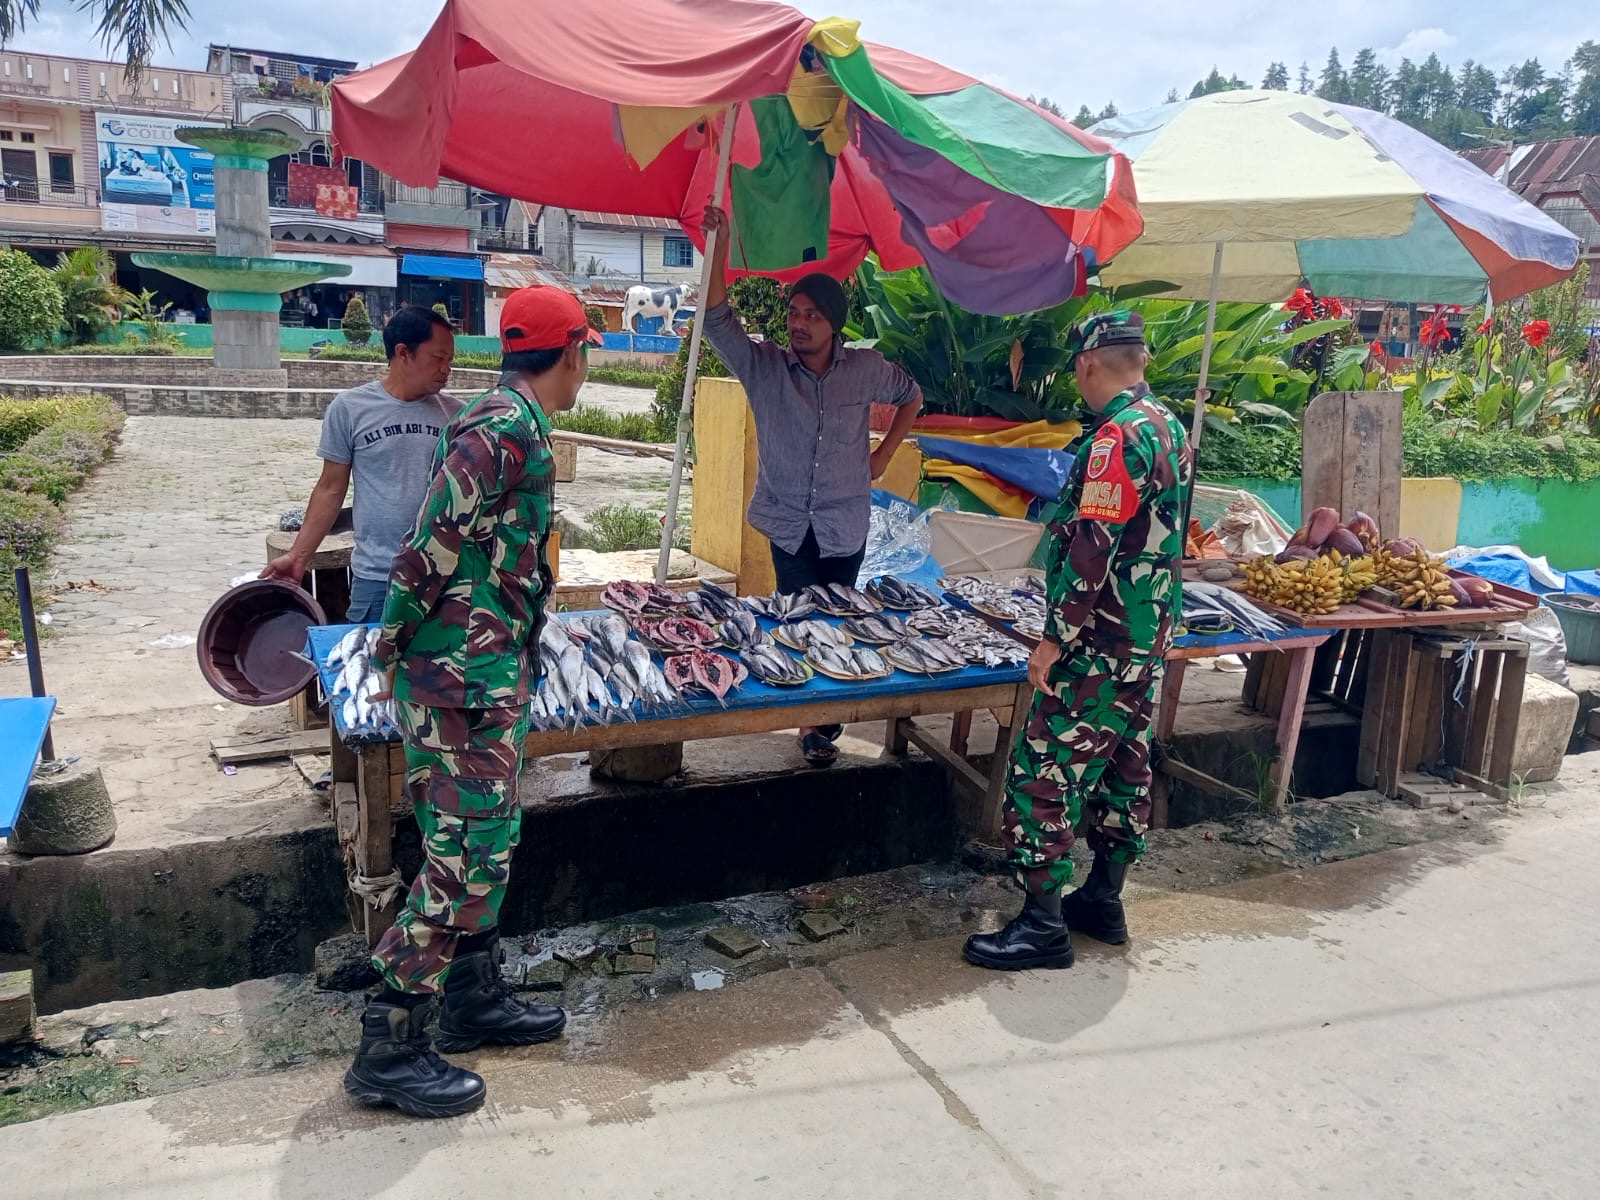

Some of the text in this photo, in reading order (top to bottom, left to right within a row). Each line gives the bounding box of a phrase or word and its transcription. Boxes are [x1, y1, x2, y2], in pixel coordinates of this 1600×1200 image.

[364, 429, 382, 445] ALI
[383, 424, 402, 437] BIN
[405, 423, 422, 434] ABI
